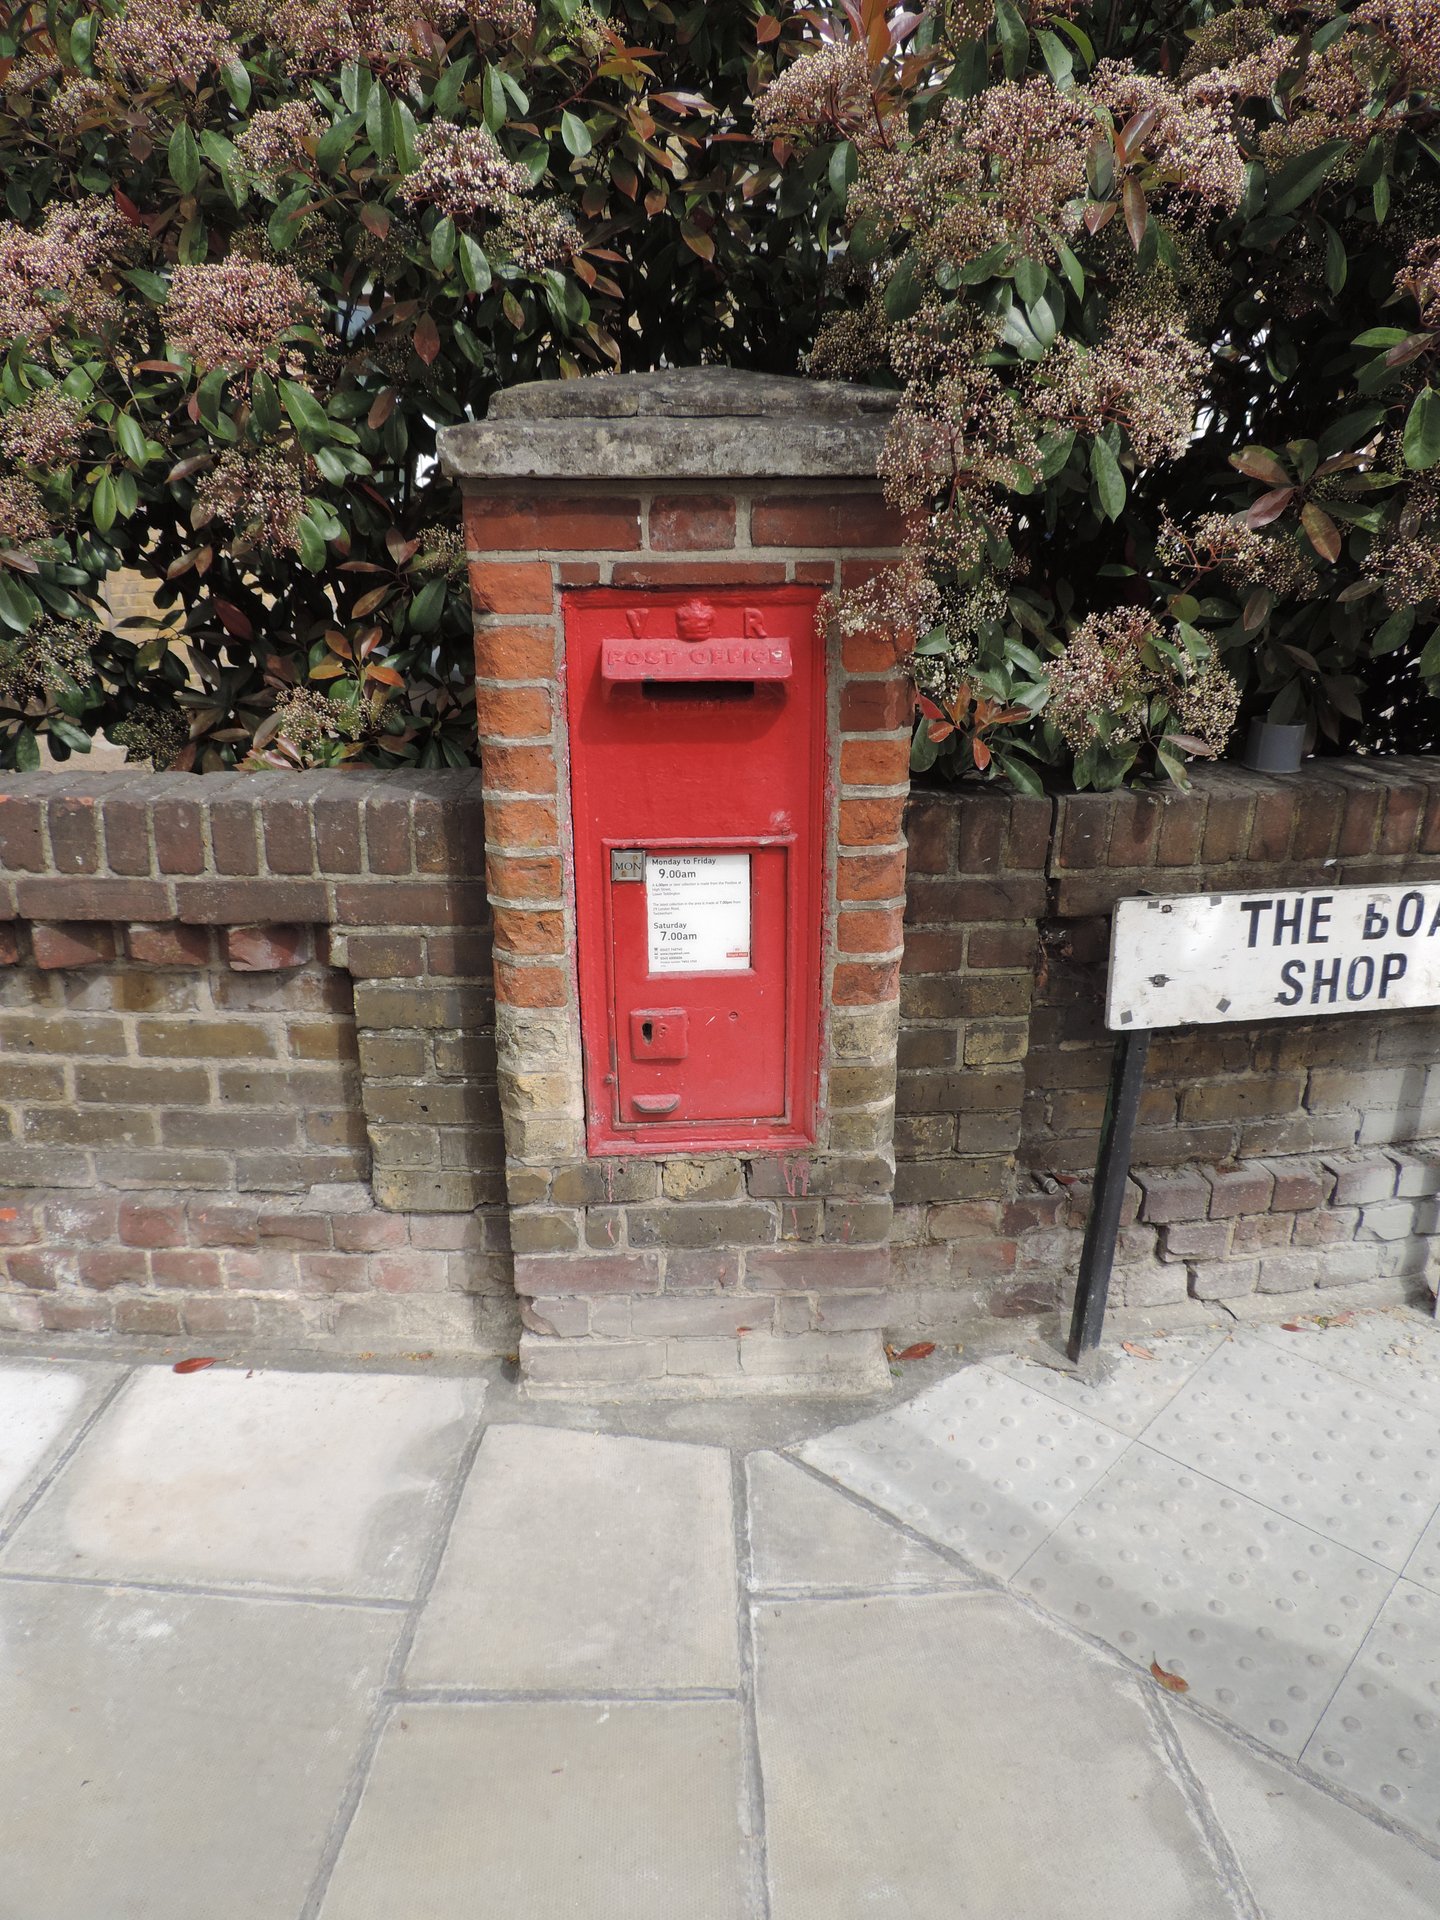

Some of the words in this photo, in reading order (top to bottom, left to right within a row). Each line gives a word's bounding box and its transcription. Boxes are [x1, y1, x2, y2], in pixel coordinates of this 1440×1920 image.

[625, 607, 649, 639] V
[743, 607, 767, 638] R
[607, 650, 677, 666] POST
[689, 649, 784, 665] OFFICE
[615, 862, 641, 871] MON
[652, 858, 681, 867] Monday
[693, 857, 717, 866] Friday
[658, 868, 697, 879] 9.00am
[653, 921, 688, 930] Saturday
[1240, 896, 1334, 948] THE
[660, 931, 698, 942] 7.00am
[1277, 952, 1408, 1006] SHOP
